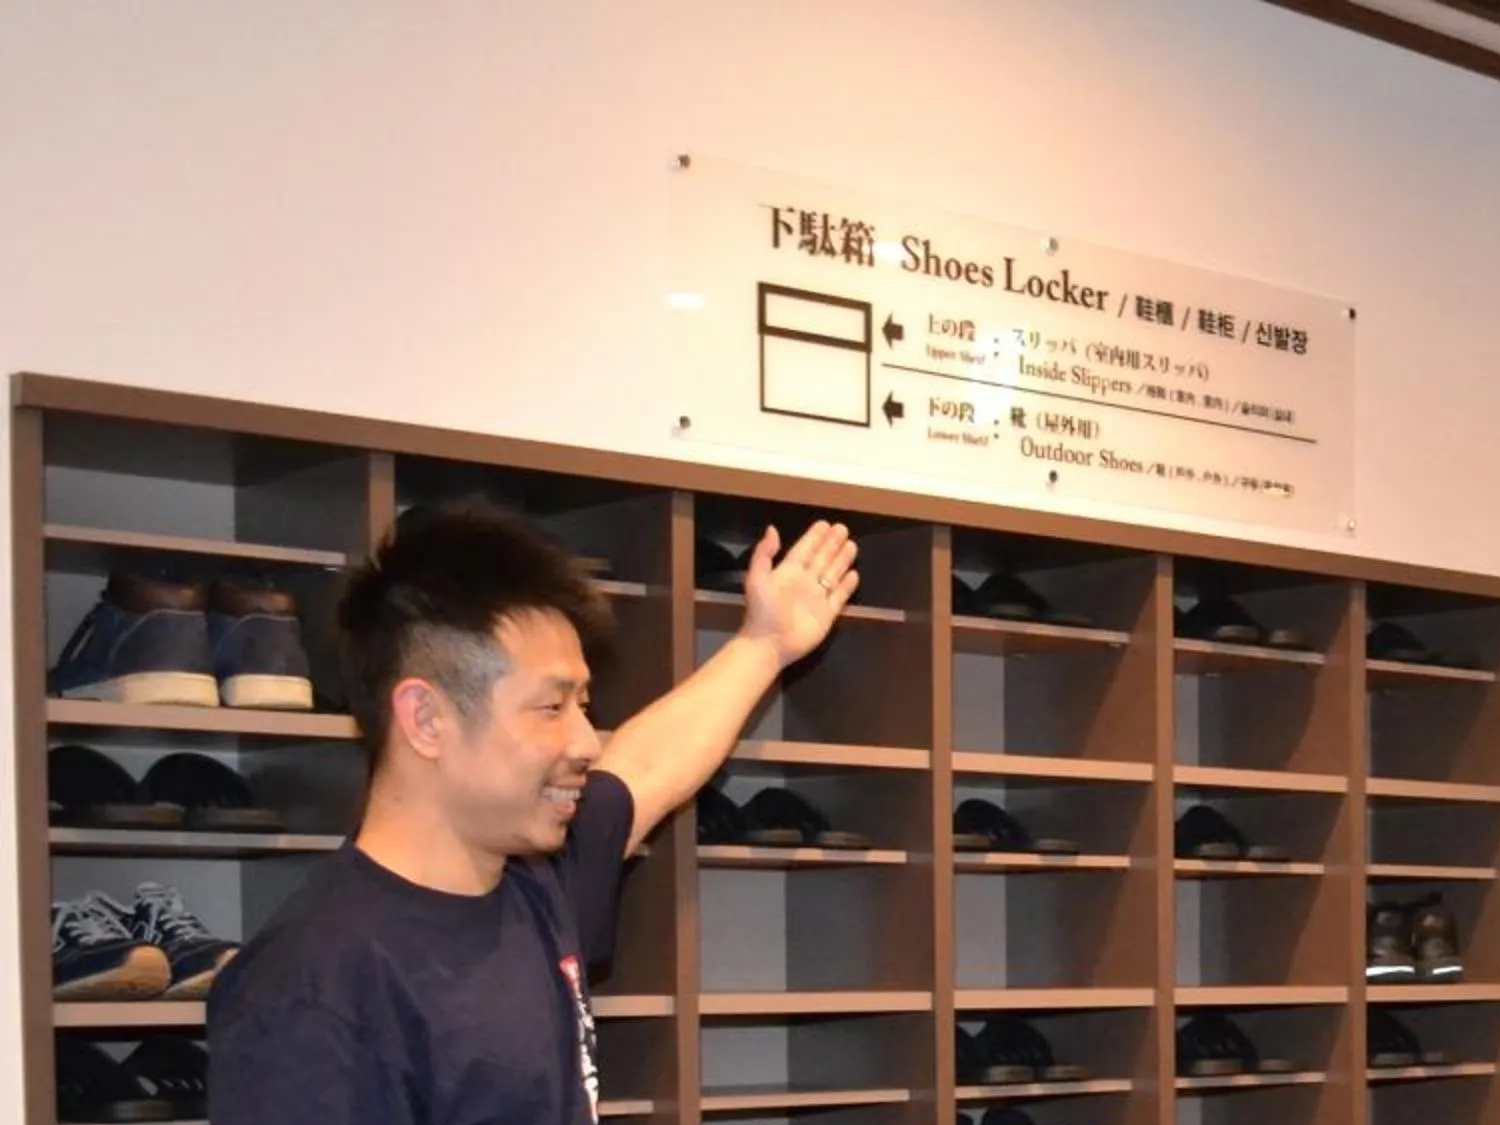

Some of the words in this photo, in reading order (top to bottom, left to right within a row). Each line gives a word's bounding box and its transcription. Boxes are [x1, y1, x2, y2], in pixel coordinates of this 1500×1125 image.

[772, 204, 875, 267] 下駄箱
[900, 235, 993, 287] Shoes
[1003, 256, 1109, 311] Locker
[1255, 322, 1308, 356] 신발장
[1018, 354, 1067, 383] Inside
[1071, 365, 1132, 396] Slippers
[1021, 436, 1094, 467] Outdoor
[1099, 448, 1143, 473] Shoes
